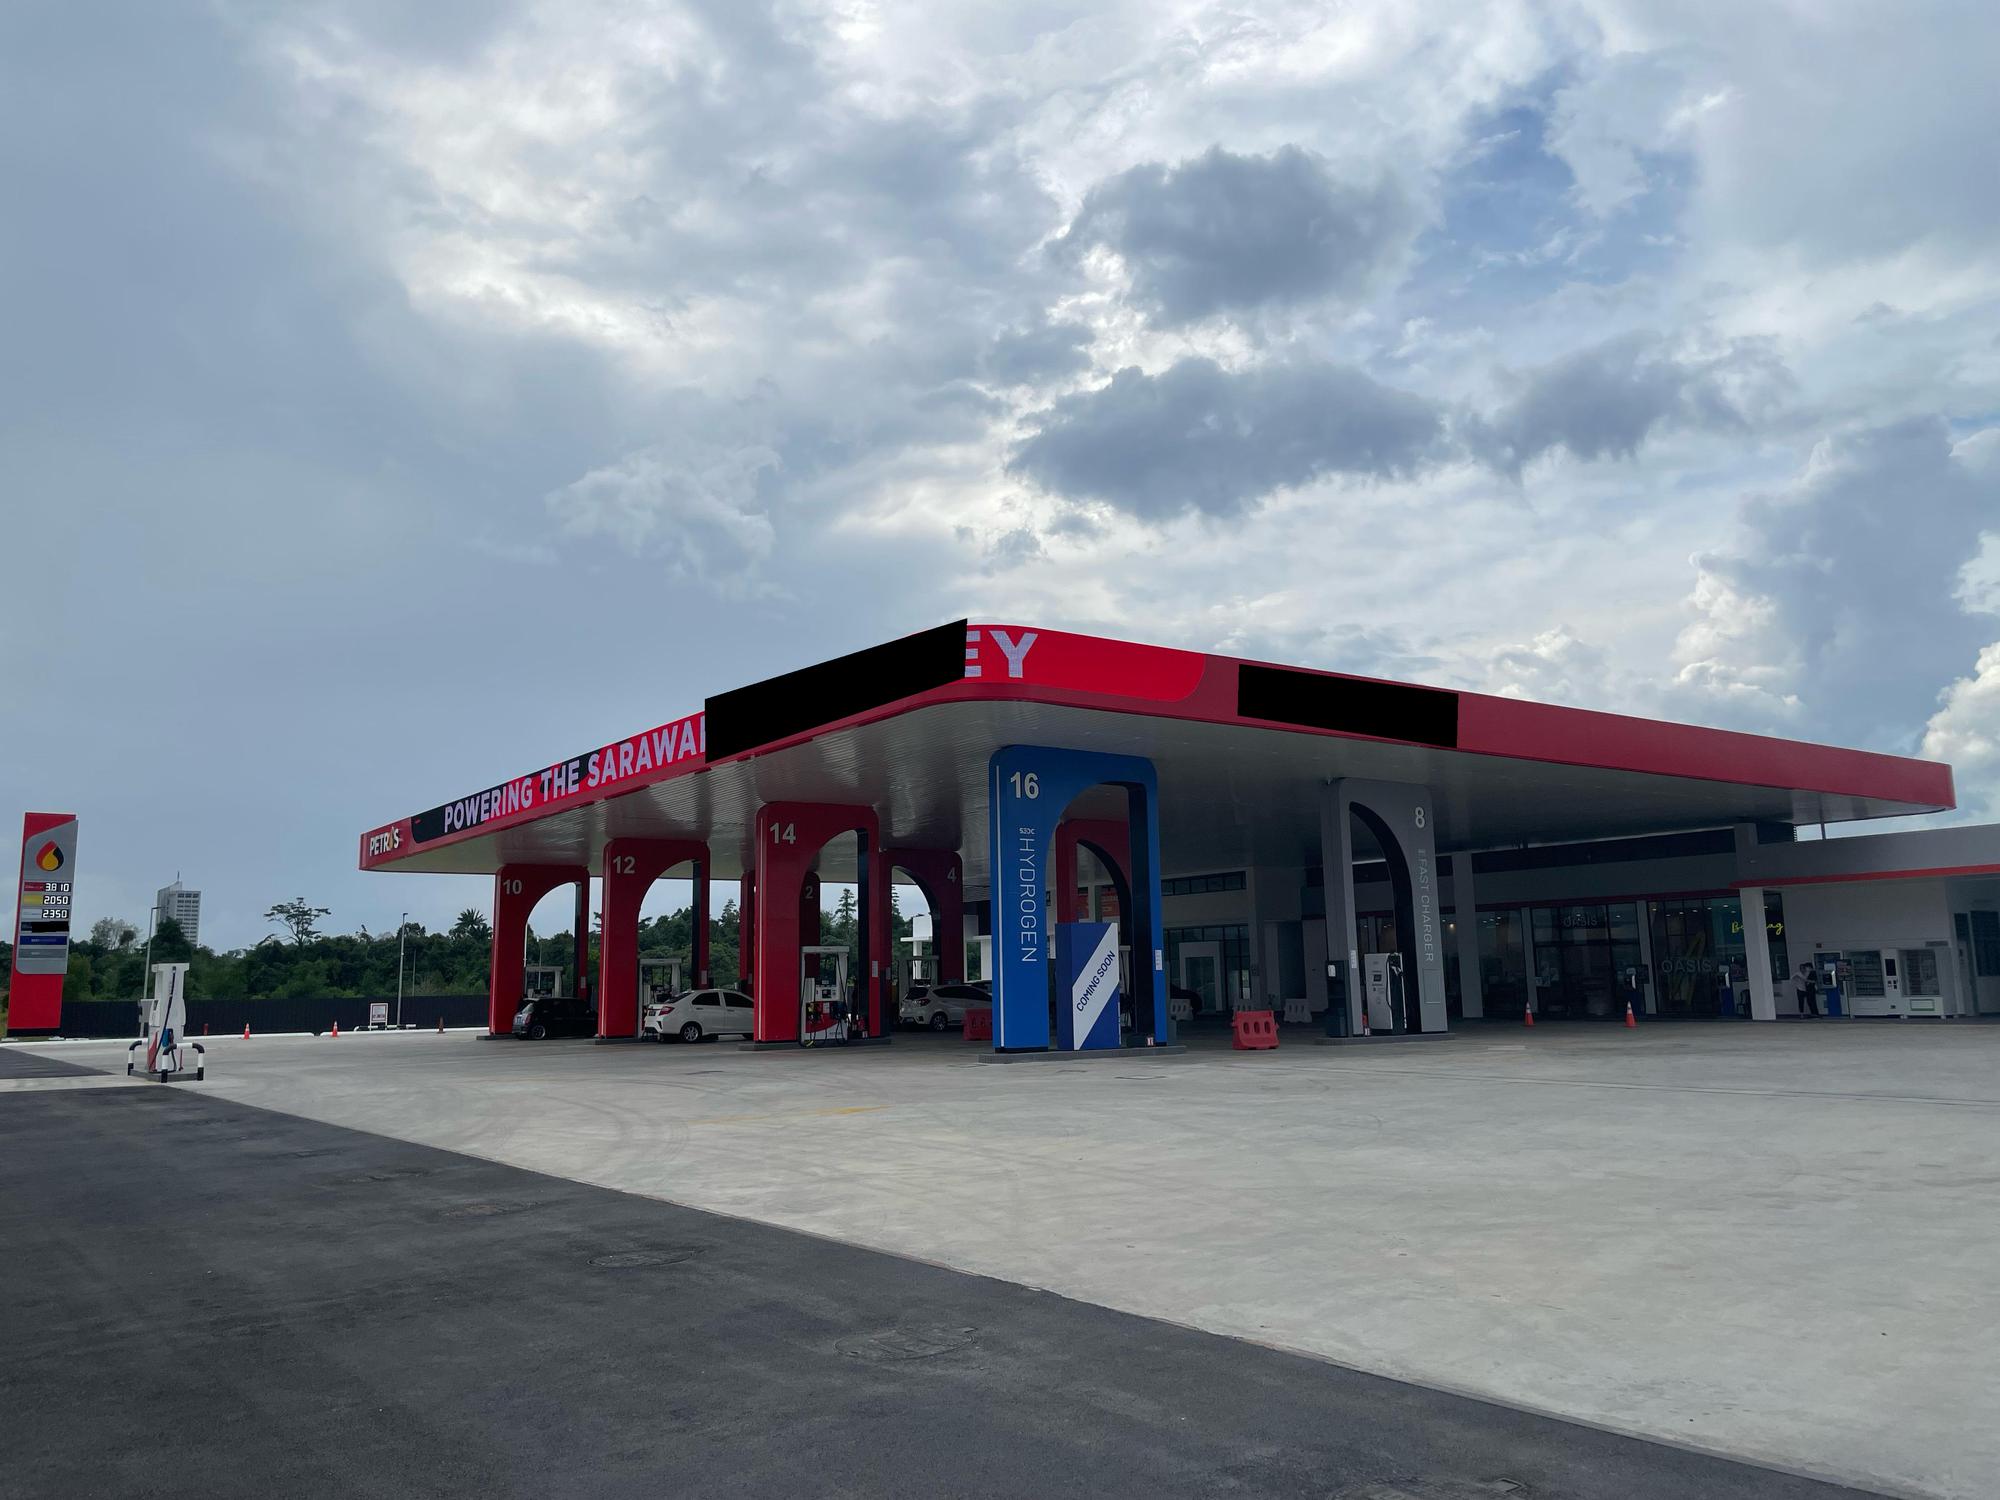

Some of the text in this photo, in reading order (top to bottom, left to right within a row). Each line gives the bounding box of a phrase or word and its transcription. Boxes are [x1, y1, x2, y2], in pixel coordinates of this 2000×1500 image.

[1010, 771, 1039, 799] 16
[444, 777, 533, 833] POWERING
[540, 760, 580, 801] THE
[1415, 806, 1425, 828] 8
[769, 823, 797, 845] 14
[612, 855, 636, 875] 12
[946, 867, 957, 883] 4
[1418, 858, 1430, 892] FAST
[503, 879, 522, 895] 10
[805, 885, 814, 899] 2
[1019, 838, 1038, 962] HYDROGEN
[1421, 895, 1434, 962] CHARGER
[1661, 959, 1712, 974] OASIS
[1076, 950, 1115, 1012] COMING SOON
